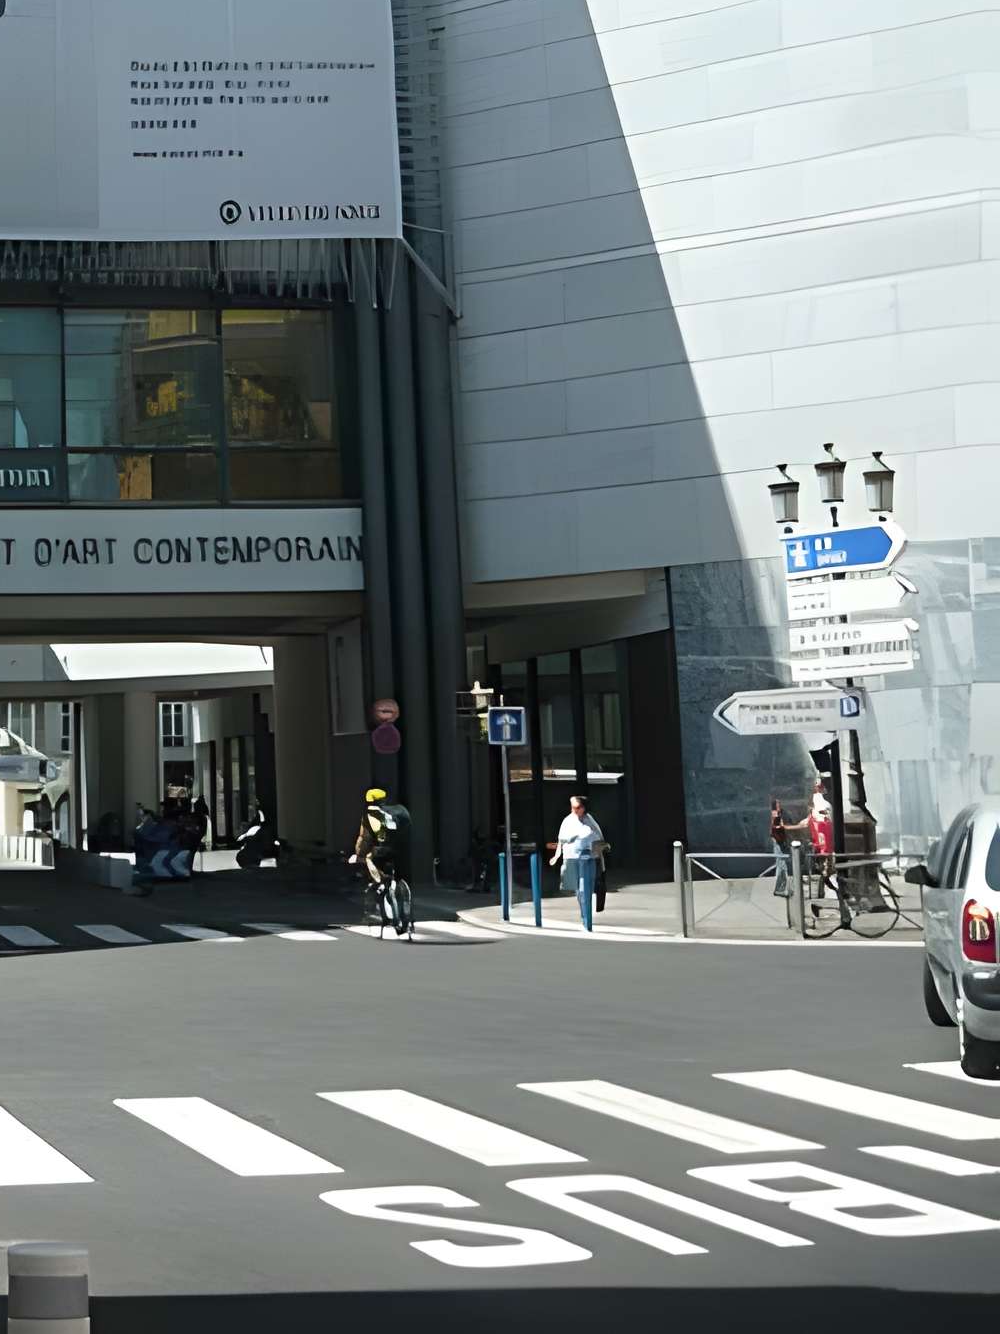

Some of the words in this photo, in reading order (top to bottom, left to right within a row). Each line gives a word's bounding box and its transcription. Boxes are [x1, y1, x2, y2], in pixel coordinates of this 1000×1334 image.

[34, 538, 117, 566] D'ART
[133, 535, 362, 564] CONTEMPORAIN
[319, 1161, 1000, 1267] BUS
